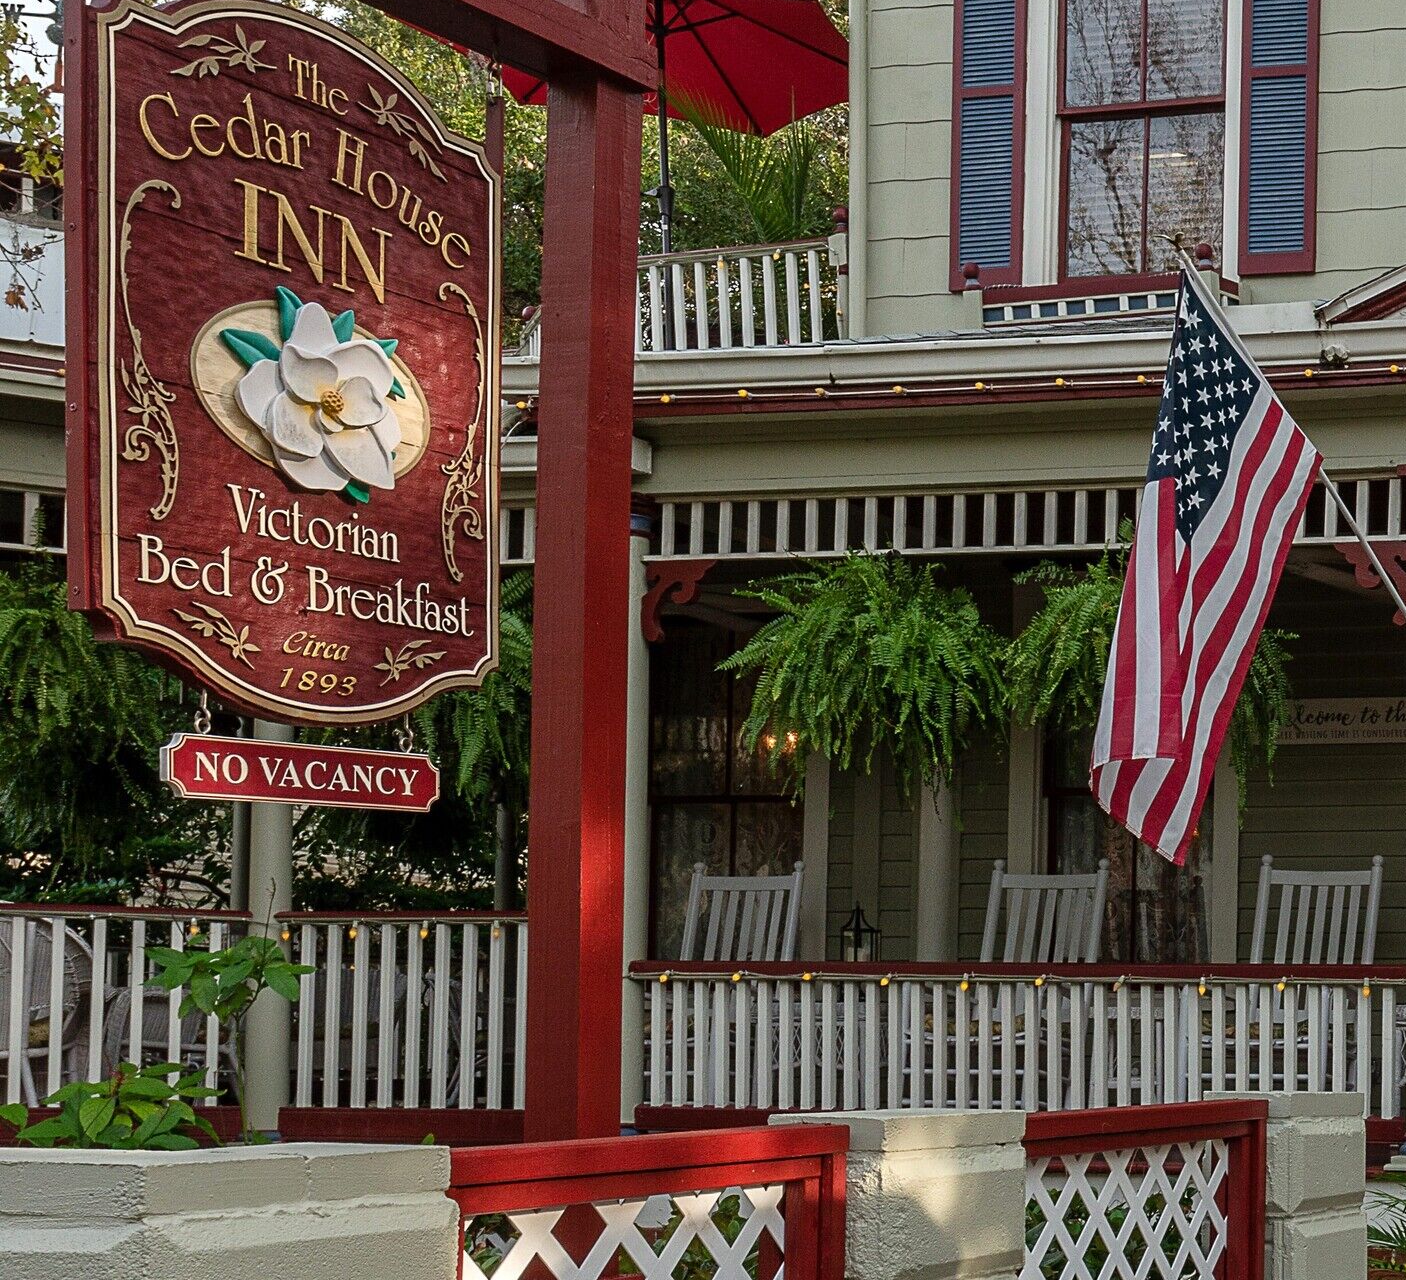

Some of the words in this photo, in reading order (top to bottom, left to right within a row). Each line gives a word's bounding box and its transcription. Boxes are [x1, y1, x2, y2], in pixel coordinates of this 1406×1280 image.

[288, 53, 349, 116] The
[139, 92, 311, 170] Cedar
[331, 128, 471, 269] House
[234, 178, 393, 305] INN
[227, 483, 401, 563] Victorian
[137, 533, 233, 598] Bed
[251, 556, 289, 605] &
[306, 565, 474, 637] Breakfast
[283, 630, 351, 662] Circa
[280, 666, 358, 697] 1893
[1272, 703, 1357, 726] elcome
[1361, 705, 1381, 724] to
[193, 751, 249, 784] NO
[258, 756, 420, 797] VACANCY
